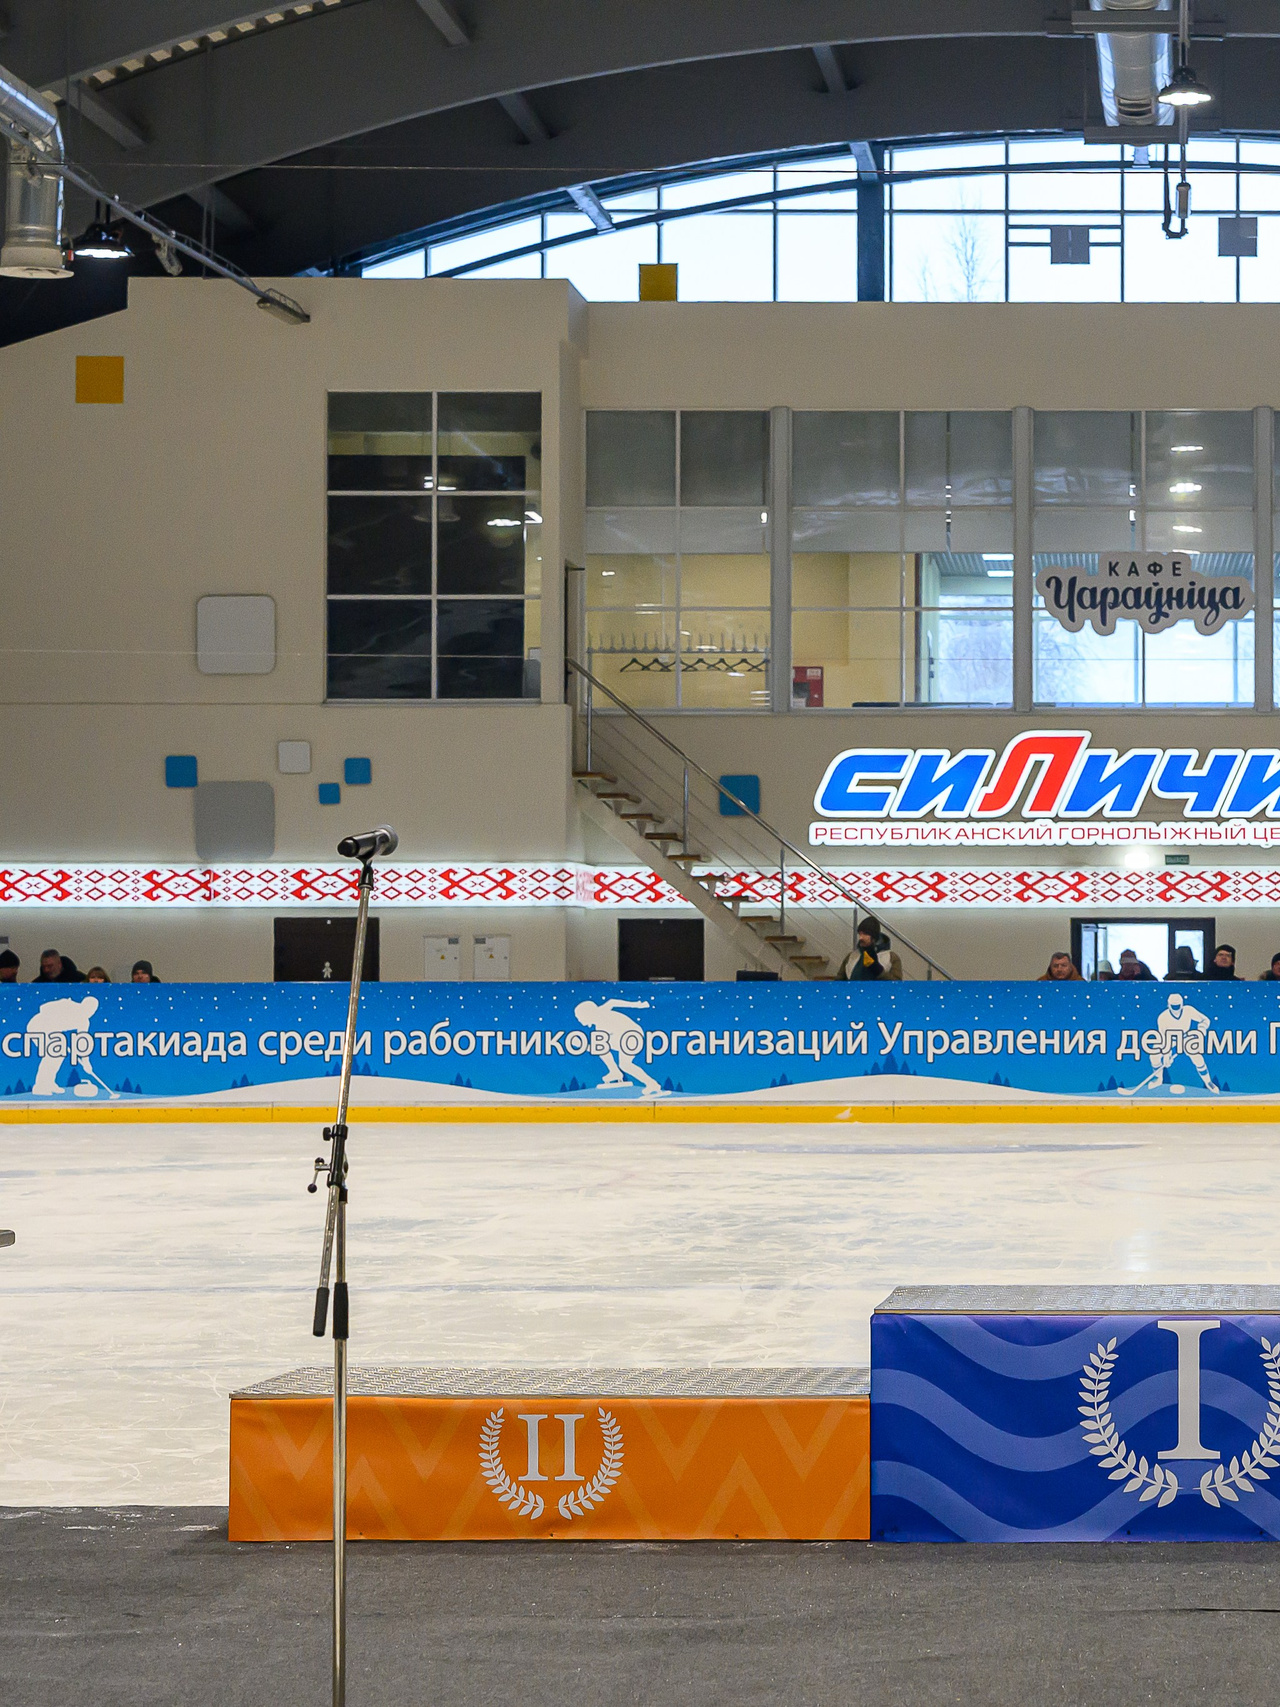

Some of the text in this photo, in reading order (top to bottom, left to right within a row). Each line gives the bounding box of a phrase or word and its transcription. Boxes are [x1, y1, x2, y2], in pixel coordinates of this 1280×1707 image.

[1108, 561, 1183, 577] КАФЕ
[1045, 576, 1245, 627] Чараўніца
[814, 823, 1052, 841] РЕСПУБЛИКАНСКИЙ
[1058, 823, 1247, 841] ГОРНОЛЫЖНЫЙ
[2, 1030, 248, 1066] спартакиада
[258, 1029, 371, 1064] среди
[384, 1021, 611, 1064] работников
[619, 1021, 868, 1064] организаций
[877, 1021, 1106, 1063] Управления
[1115, 1029, 1257, 1061] делами
[1157, 1320, 1220, 1459] I
[517, 1414, 585, 1481] II
